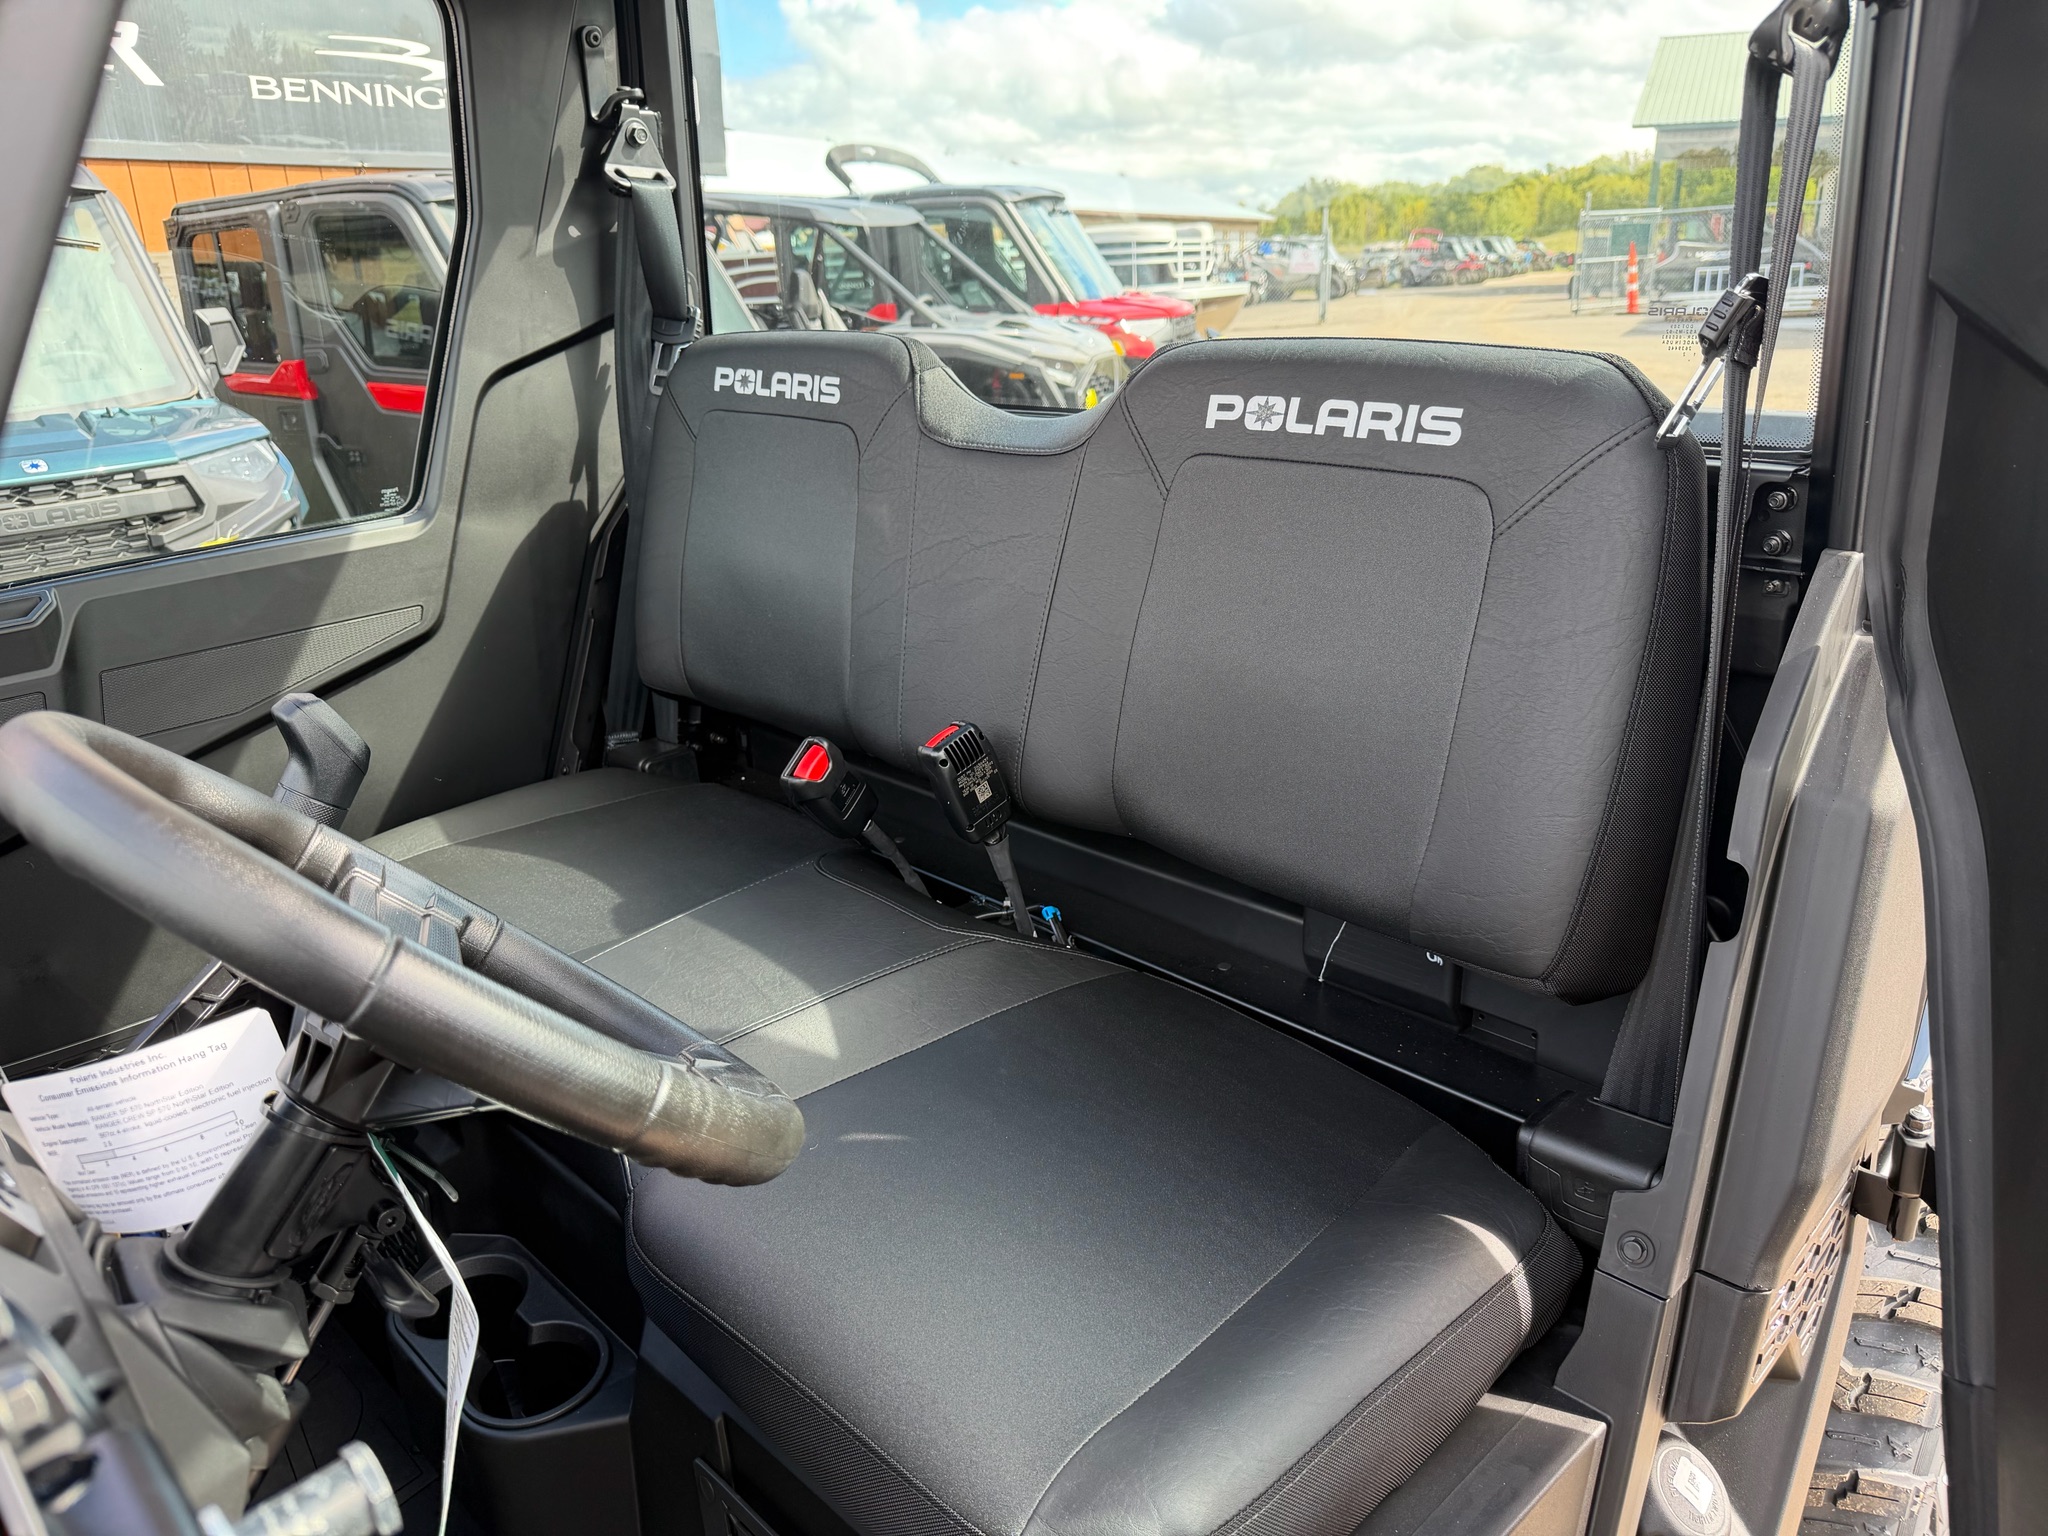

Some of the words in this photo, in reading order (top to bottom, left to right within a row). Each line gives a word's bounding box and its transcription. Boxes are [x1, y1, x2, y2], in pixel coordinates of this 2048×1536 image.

[248, 75, 446, 110] BENNING
[713, 366, 841, 405] POLARIS
[1205, 394, 1464, 446] POLARIS
[0, 500, 122, 532] OLARIS
[38, 1089, 75, 1102] Consumer
[75, 1079, 119, 1096] Emissions
[119, 1062, 177, 1083] Information
[178, 1050, 207, 1066] Hang
[207, 1040, 229, 1054] Tag
[69, 1073, 98, 1085] Polaris
[99, 1059, 146, 1078] Industries
[208, 1080, 235, 1096] Edition
[191, 1094, 227, 1112] electronic
[227, 1087, 242, 1099] fuel
[242, 1075, 273, 1093] injection
